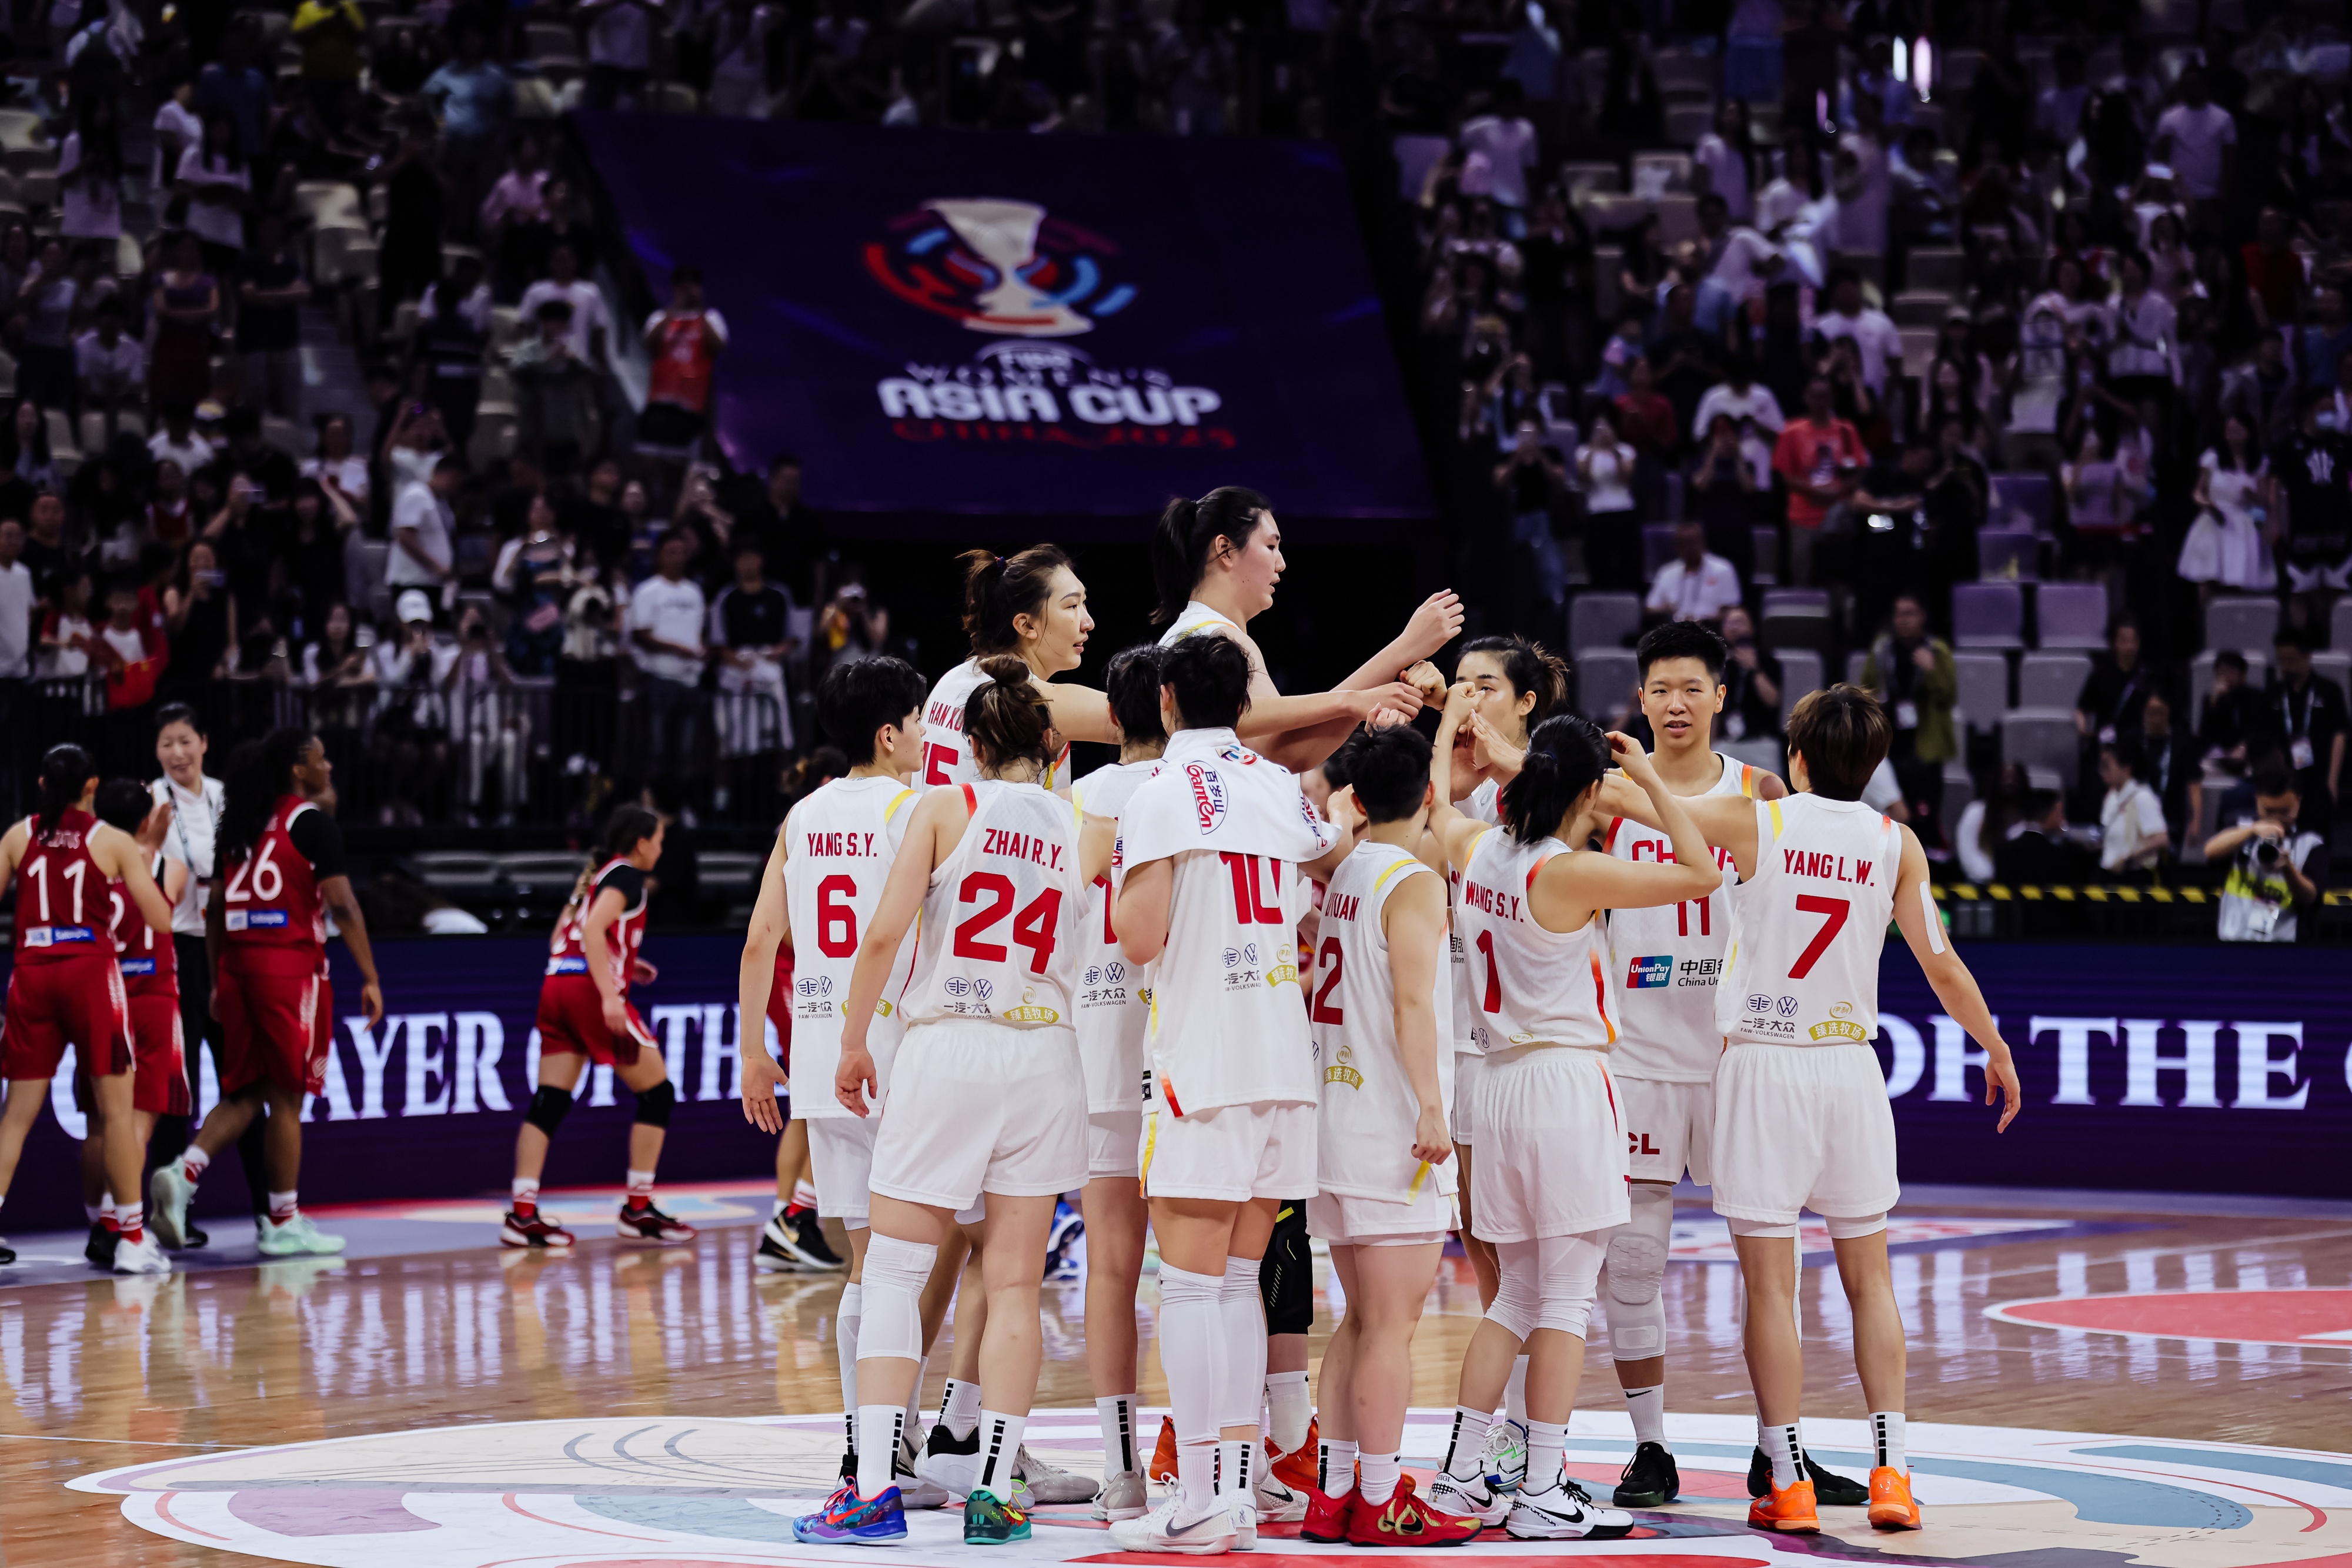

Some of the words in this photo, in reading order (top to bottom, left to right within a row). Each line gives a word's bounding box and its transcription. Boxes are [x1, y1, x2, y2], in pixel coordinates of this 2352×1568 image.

[877, 377, 1061, 423] ASIA
[1068, 383, 1222, 426] CUP
[928, 701, 951, 727] HAN
[1204, 771, 1225, 813] 百岁山
[807, 832, 843, 857] YANG
[846, 832, 877, 857] S.Y.
[983, 828, 1030, 860] ZHAI
[1031, 838, 1064, 872] R.Y.
[225, 837, 283, 902] 26
[1218, 851, 1284, 925] 10
[1783, 848, 1833, 879] YANG
[1837, 856, 1875, 887] L.W.
[27, 854, 87, 924] 11
[1465, 880, 1493, 914] WANG
[1495, 891, 1524, 923] S.Y.
[817, 874, 858, 958] 6
[953, 871, 1063, 975] 24
[1672, 894, 1710, 937] 11
[1788, 894, 1850, 979] 7
[1312, 936, 1344, 1026] 2
[1476, 929, 1502, 1014] 1
[1631, 963, 1671, 975] UnionPay
[1646, 972, 1666, 982] 银联
[1678, 977, 1706, 987] China
[1009, 1007, 1054, 1022] 臻选牧场
[1081, 988, 1126, 1001] 一汽-大众
[1081, 1000, 1127, 1009] FAW-VOLKSWAGEN
[1740, 1027, 1795, 1039] FAW-VOLKSWAGEN
[1742, 1018, 1796, 1033] 一汽-大众
[1815, 1022, 1863, 1040] 臻选牧场
[298, 1011, 514, 1123] AYER
[650, 1002, 791, 1103] TH
[2029, 1015, 2311, 1111] THE
[1325, 1067, 1359, 1086] 臻选牧场
